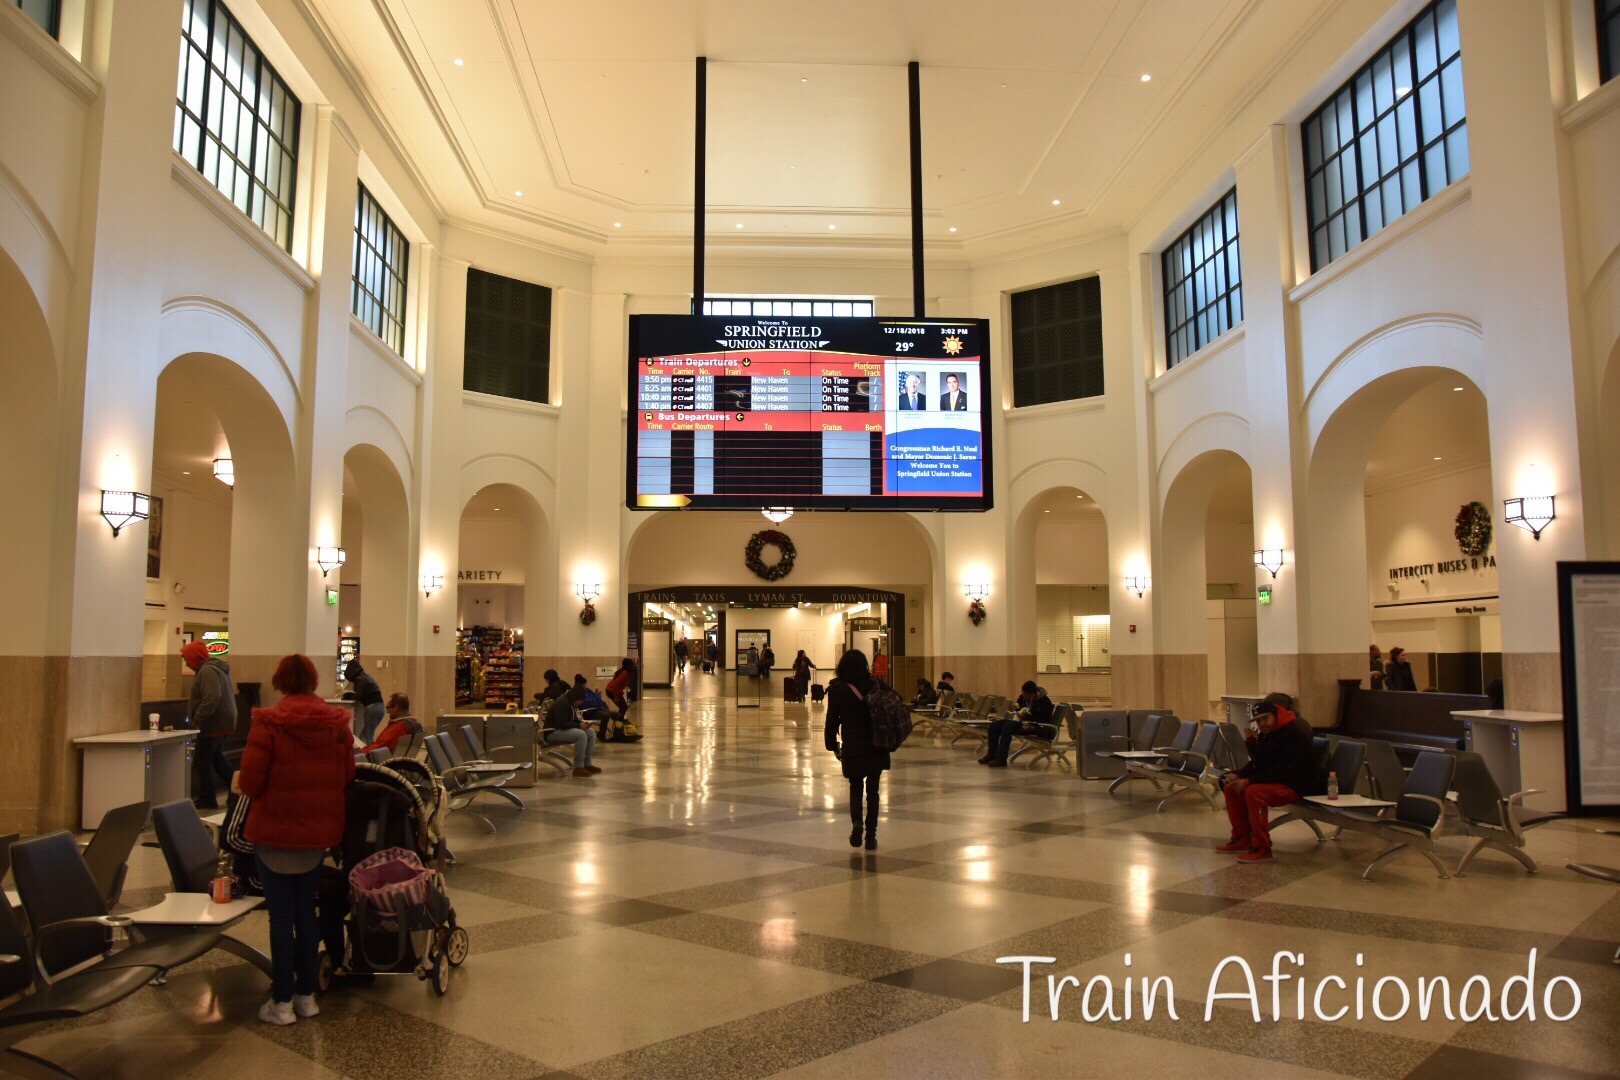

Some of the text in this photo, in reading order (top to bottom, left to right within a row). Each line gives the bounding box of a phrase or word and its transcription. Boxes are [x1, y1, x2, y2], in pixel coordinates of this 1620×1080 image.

[724, 326, 822, 338] SPRINGFIELD
[728, 340, 818, 349] UNION STATION
[658, 358, 738, 368] Train Departures
[853, 362, 881, 370] Platform
[678, 412, 730, 422] Departures
[1389, 564, 1434, 579] INTERCITY
[1436, 558, 1468, 574] BUSES
[1471, 558, 1478, 570] &
[638, 593, 676, 601] TRAINS
[748, 593, 785, 602] LYMAN
[791, 593, 807, 602] ST.
[832, 593, 897, 602] DOWNTOWN
[206, 644, 227, 652] OPEN
